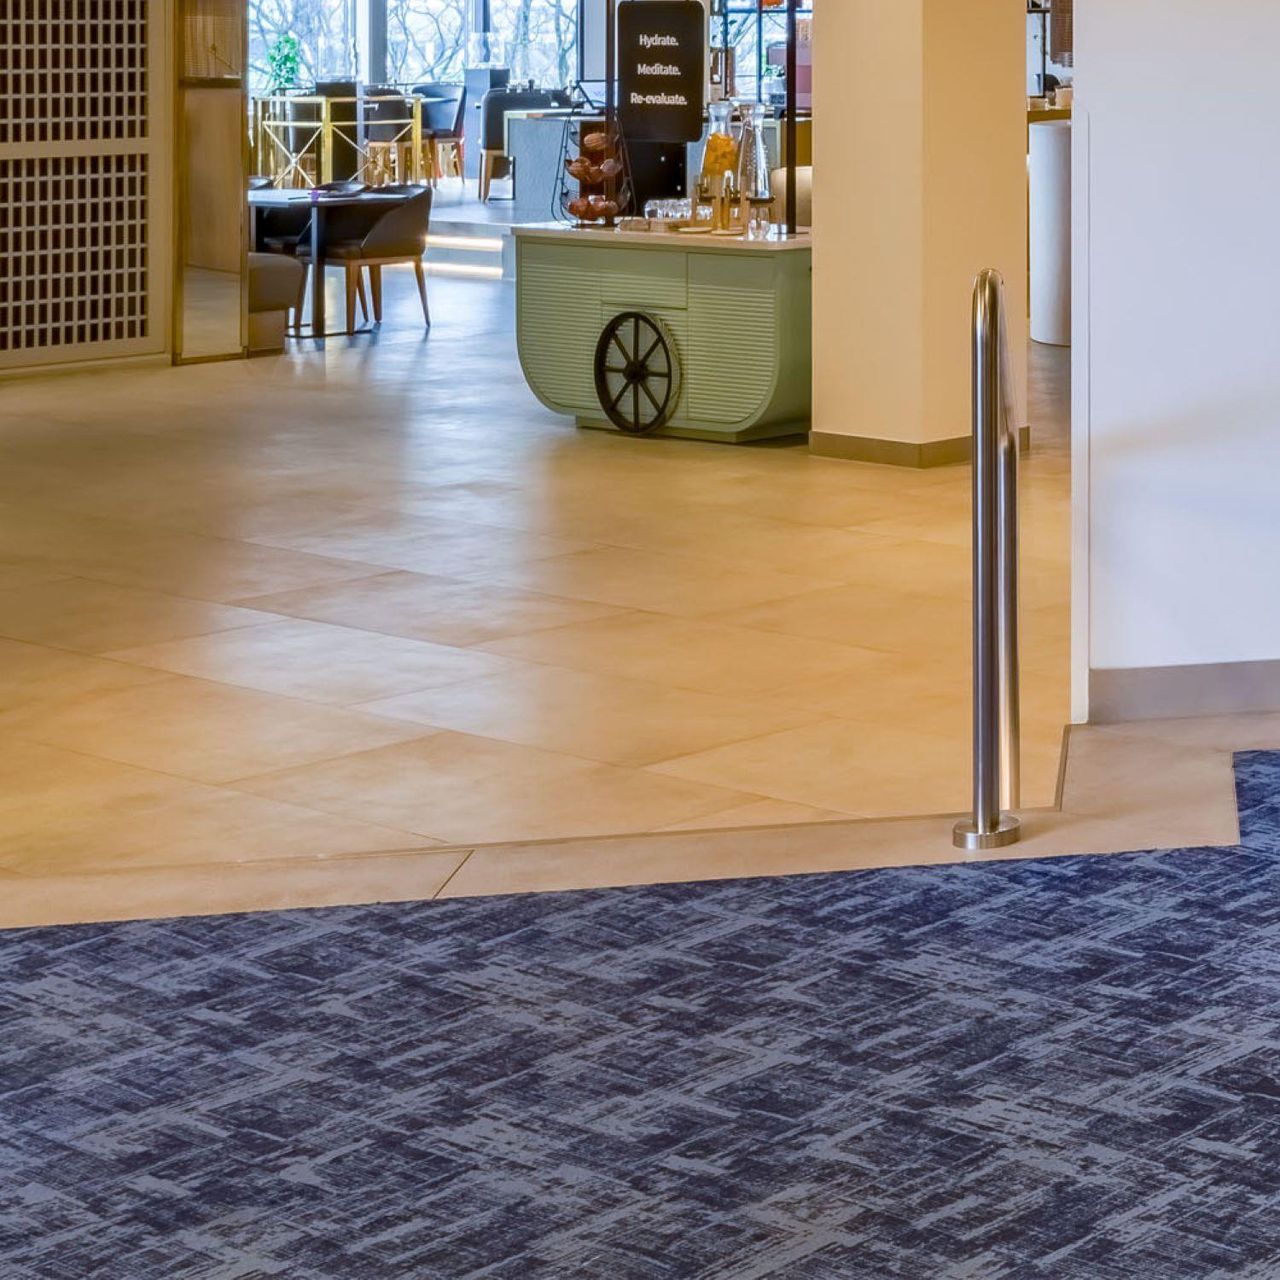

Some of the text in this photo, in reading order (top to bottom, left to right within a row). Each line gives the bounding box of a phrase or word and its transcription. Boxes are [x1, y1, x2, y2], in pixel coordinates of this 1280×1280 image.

[639, 33, 679, 48] Hydrate.
[637, 63, 681, 76] Meditate.
[630, 92, 688, 106] Re-evaluate.
